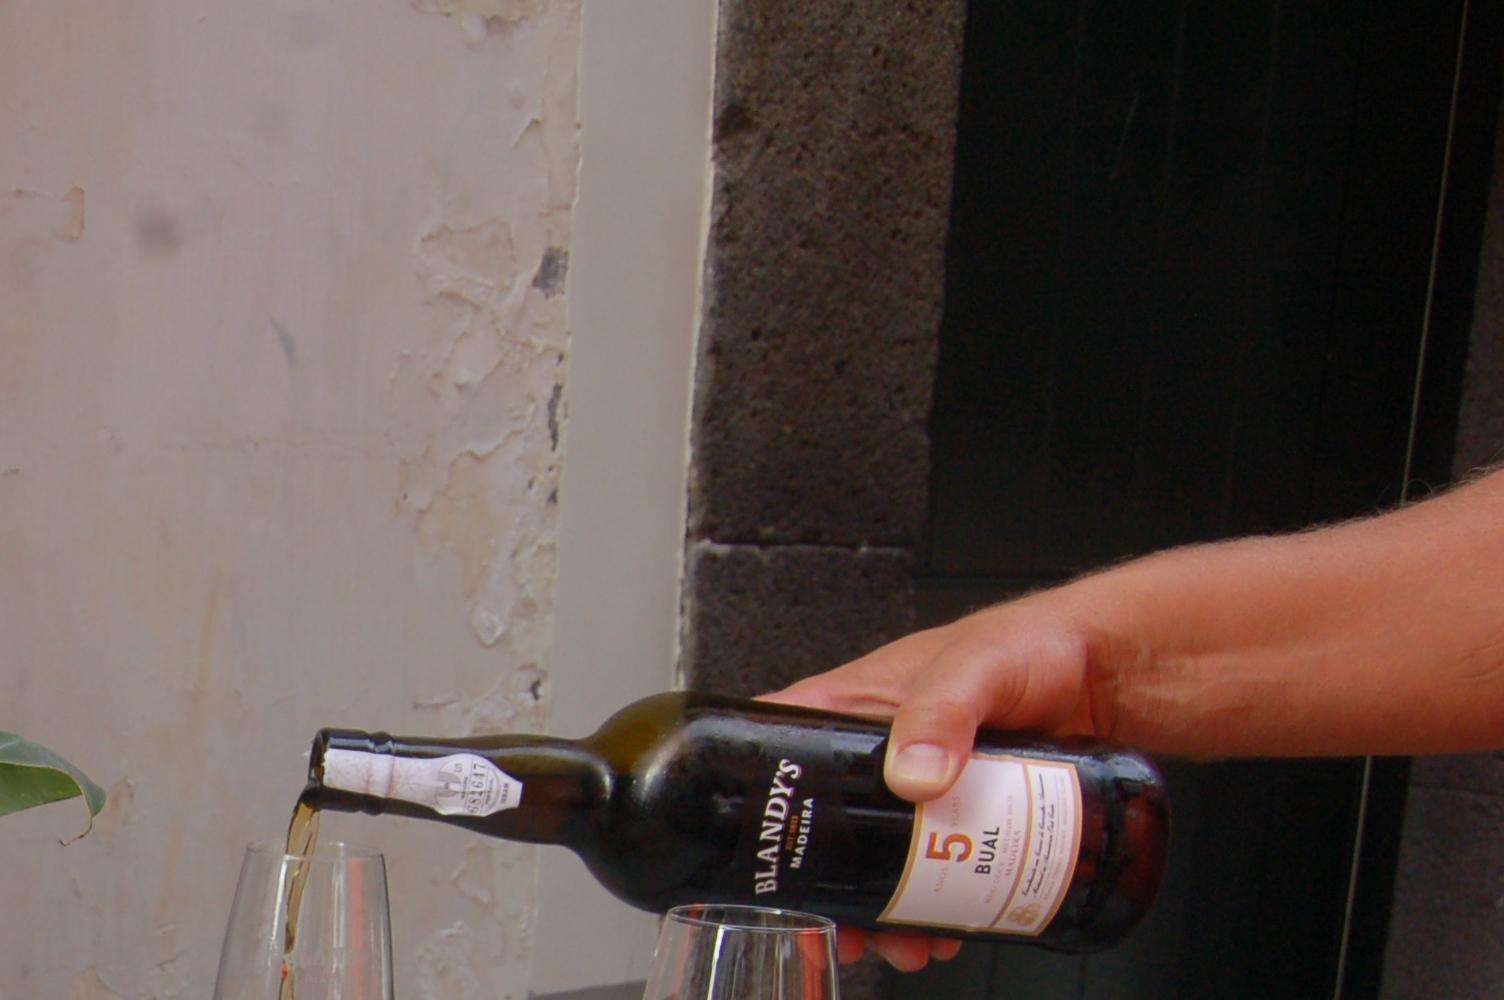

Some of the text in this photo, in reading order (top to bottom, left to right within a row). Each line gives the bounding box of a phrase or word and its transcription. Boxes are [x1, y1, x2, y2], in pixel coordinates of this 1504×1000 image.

[754, 757, 803, 897] BLANDY'S
[790, 798, 814, 870] MADEIRA
[925, 831, 975, 864] 5
[974, 826, 1000, 875] BUAL
